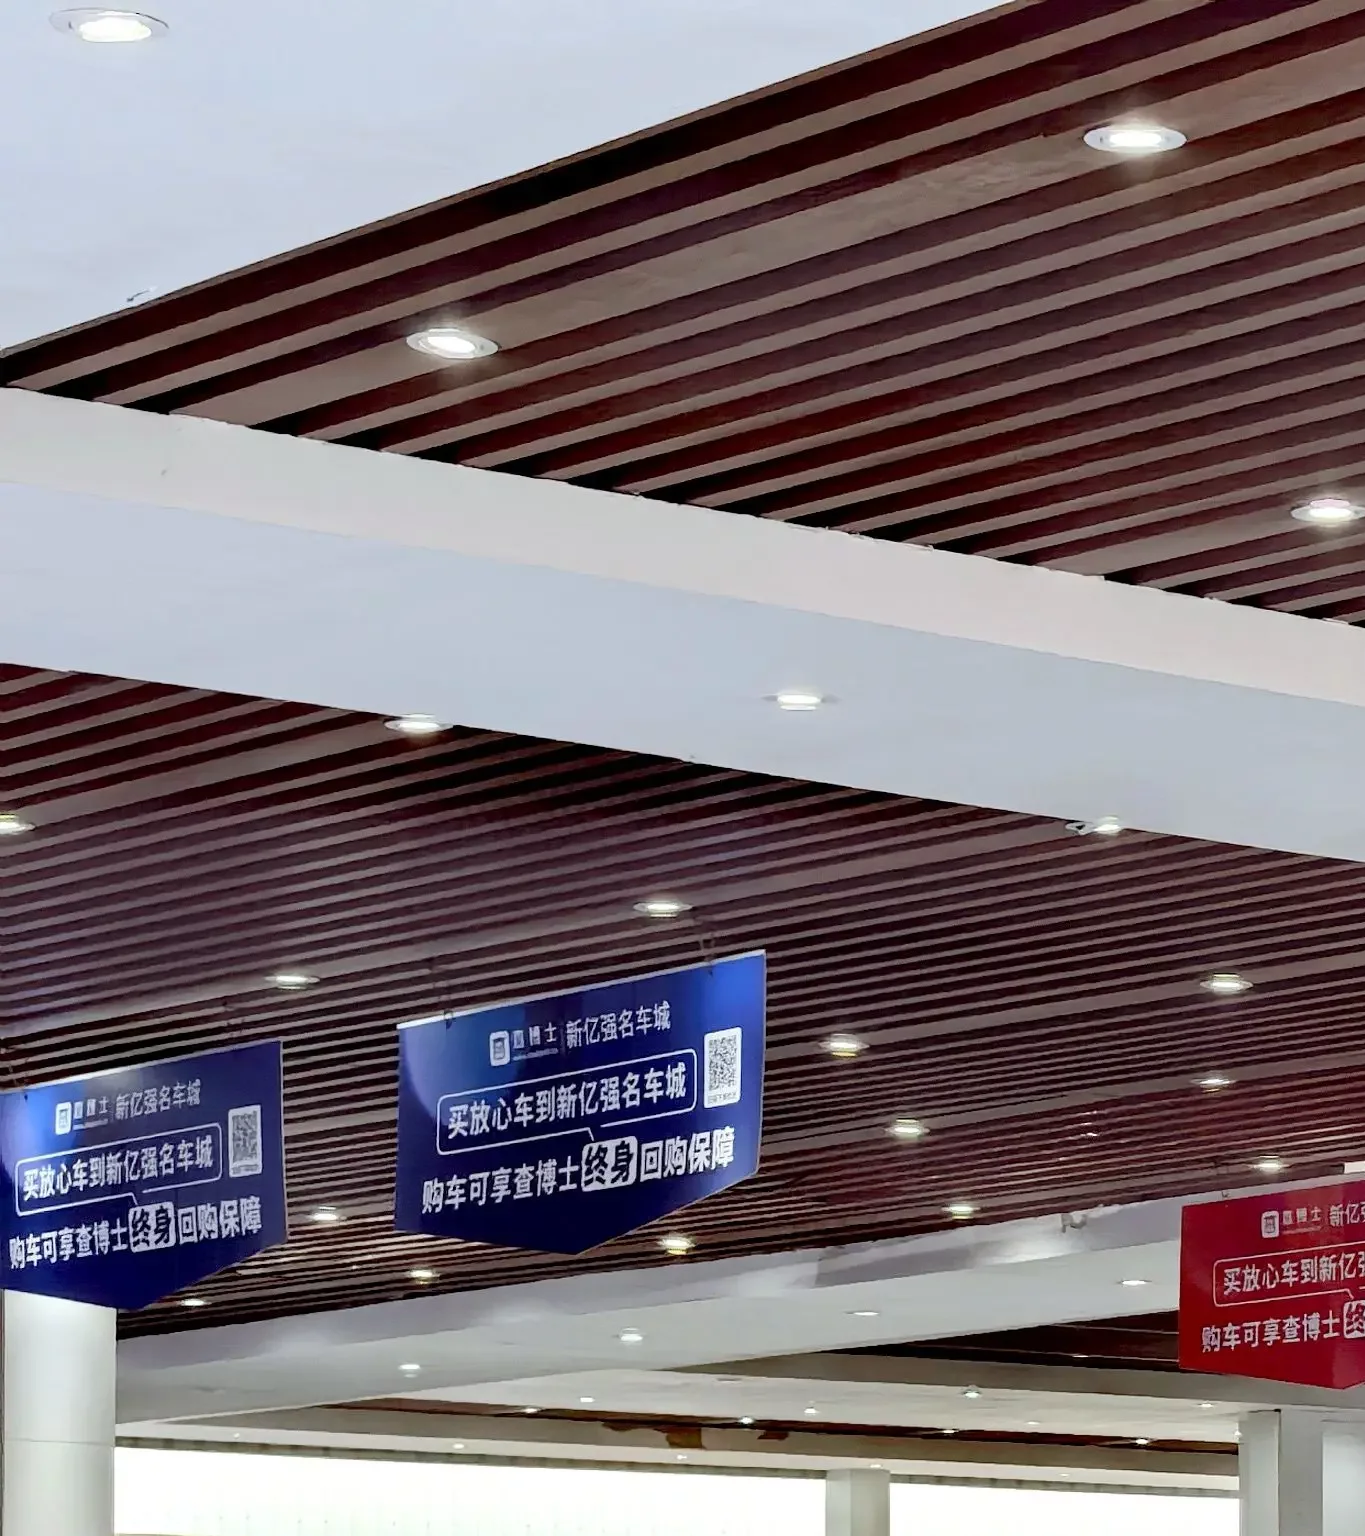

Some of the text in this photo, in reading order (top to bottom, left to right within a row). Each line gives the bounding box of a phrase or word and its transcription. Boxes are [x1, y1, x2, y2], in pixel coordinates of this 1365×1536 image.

[566, 1000, 671, 1048] 新亿强名车城
[115, 1079, 201, 1120] 新亿强名车城
[448, 1062, 687, 1140] 买放心车到新亿强名车城
[23, 1135, 214, 1201] 买放心车到新亿强名车城
[422, 1126, 735, 1214] 购车可享查博士终身回购保障
[9, 1196, 262, 1270] 购车可享查博士终身回购保障
